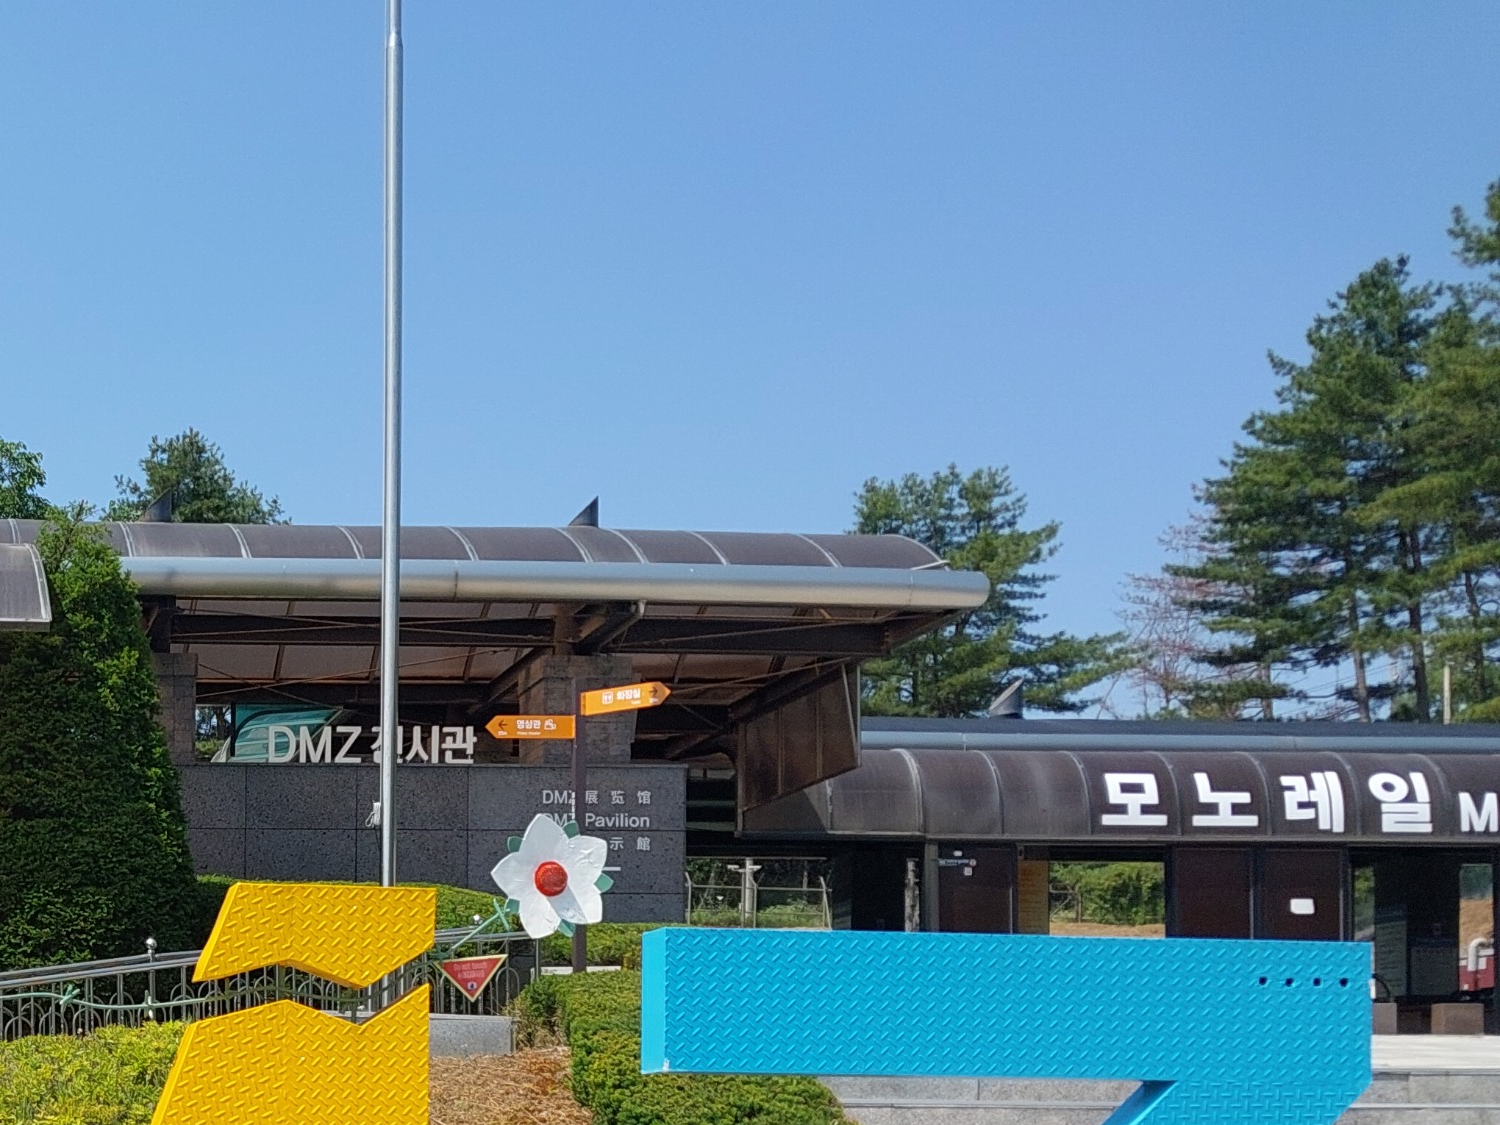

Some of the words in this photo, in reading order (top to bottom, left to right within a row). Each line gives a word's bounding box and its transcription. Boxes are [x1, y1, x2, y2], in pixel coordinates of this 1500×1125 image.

[268, 725, 362, 764] DMZ
[585, 812, 650, 828] Pavilion
[1101, 771, 1433, 834] 모노레일
